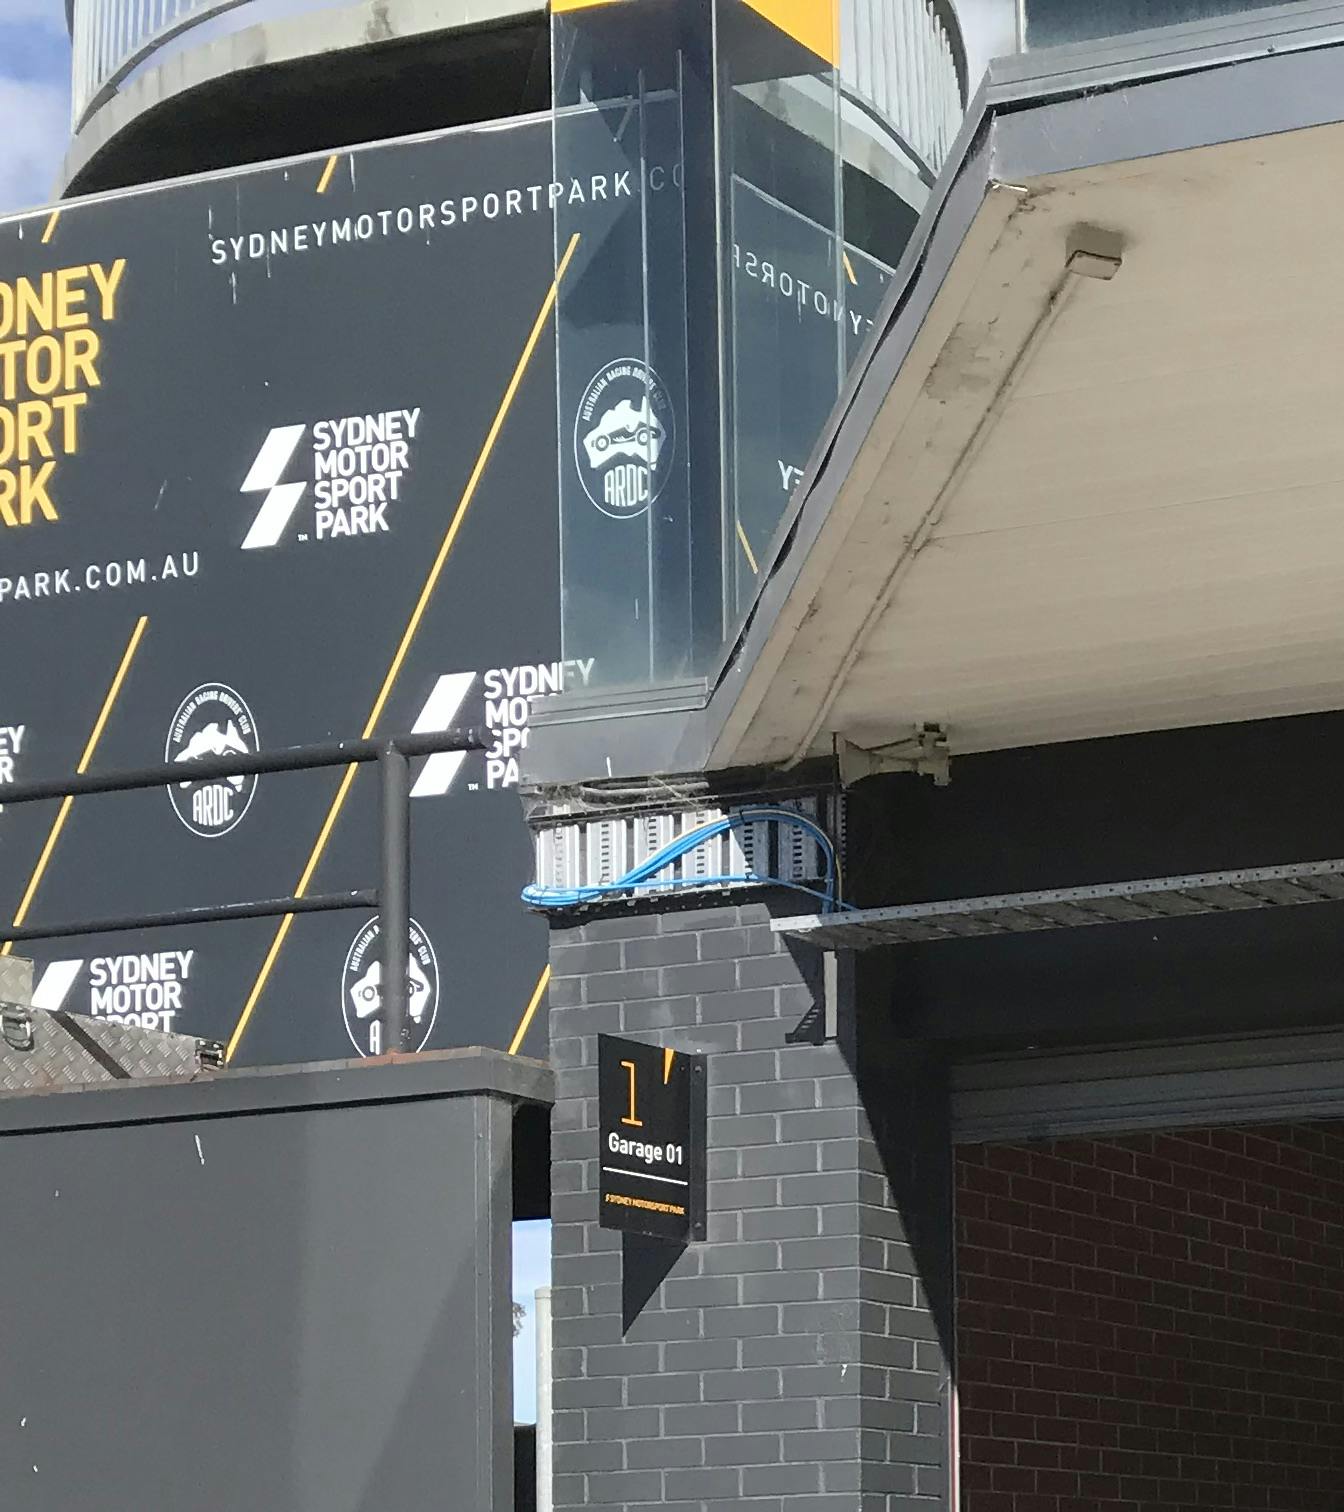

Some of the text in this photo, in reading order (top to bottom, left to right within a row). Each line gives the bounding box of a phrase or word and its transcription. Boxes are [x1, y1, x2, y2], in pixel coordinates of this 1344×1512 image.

[312, 407, 420, 451] SYDNEY
[314, 440, 409, 480] MOTOR
[314, 471, 402, 510] SPORT
[316, 502, 389, 540] PARK
[483, 658, 595, 699] SYDNEY
[172, 701, 197, 743] AUSTRALIAN
[192, 784, 234, 827] ARDC
[89, 950, 194, 987] SYDNEY
[349, 928, 375, 972] AUSTRALIAN
[90, 982, 182, 1017] MOTOR
[620, 1061, 643, 1127] 1
[607, 1132, 683, 1166] Garage 01
